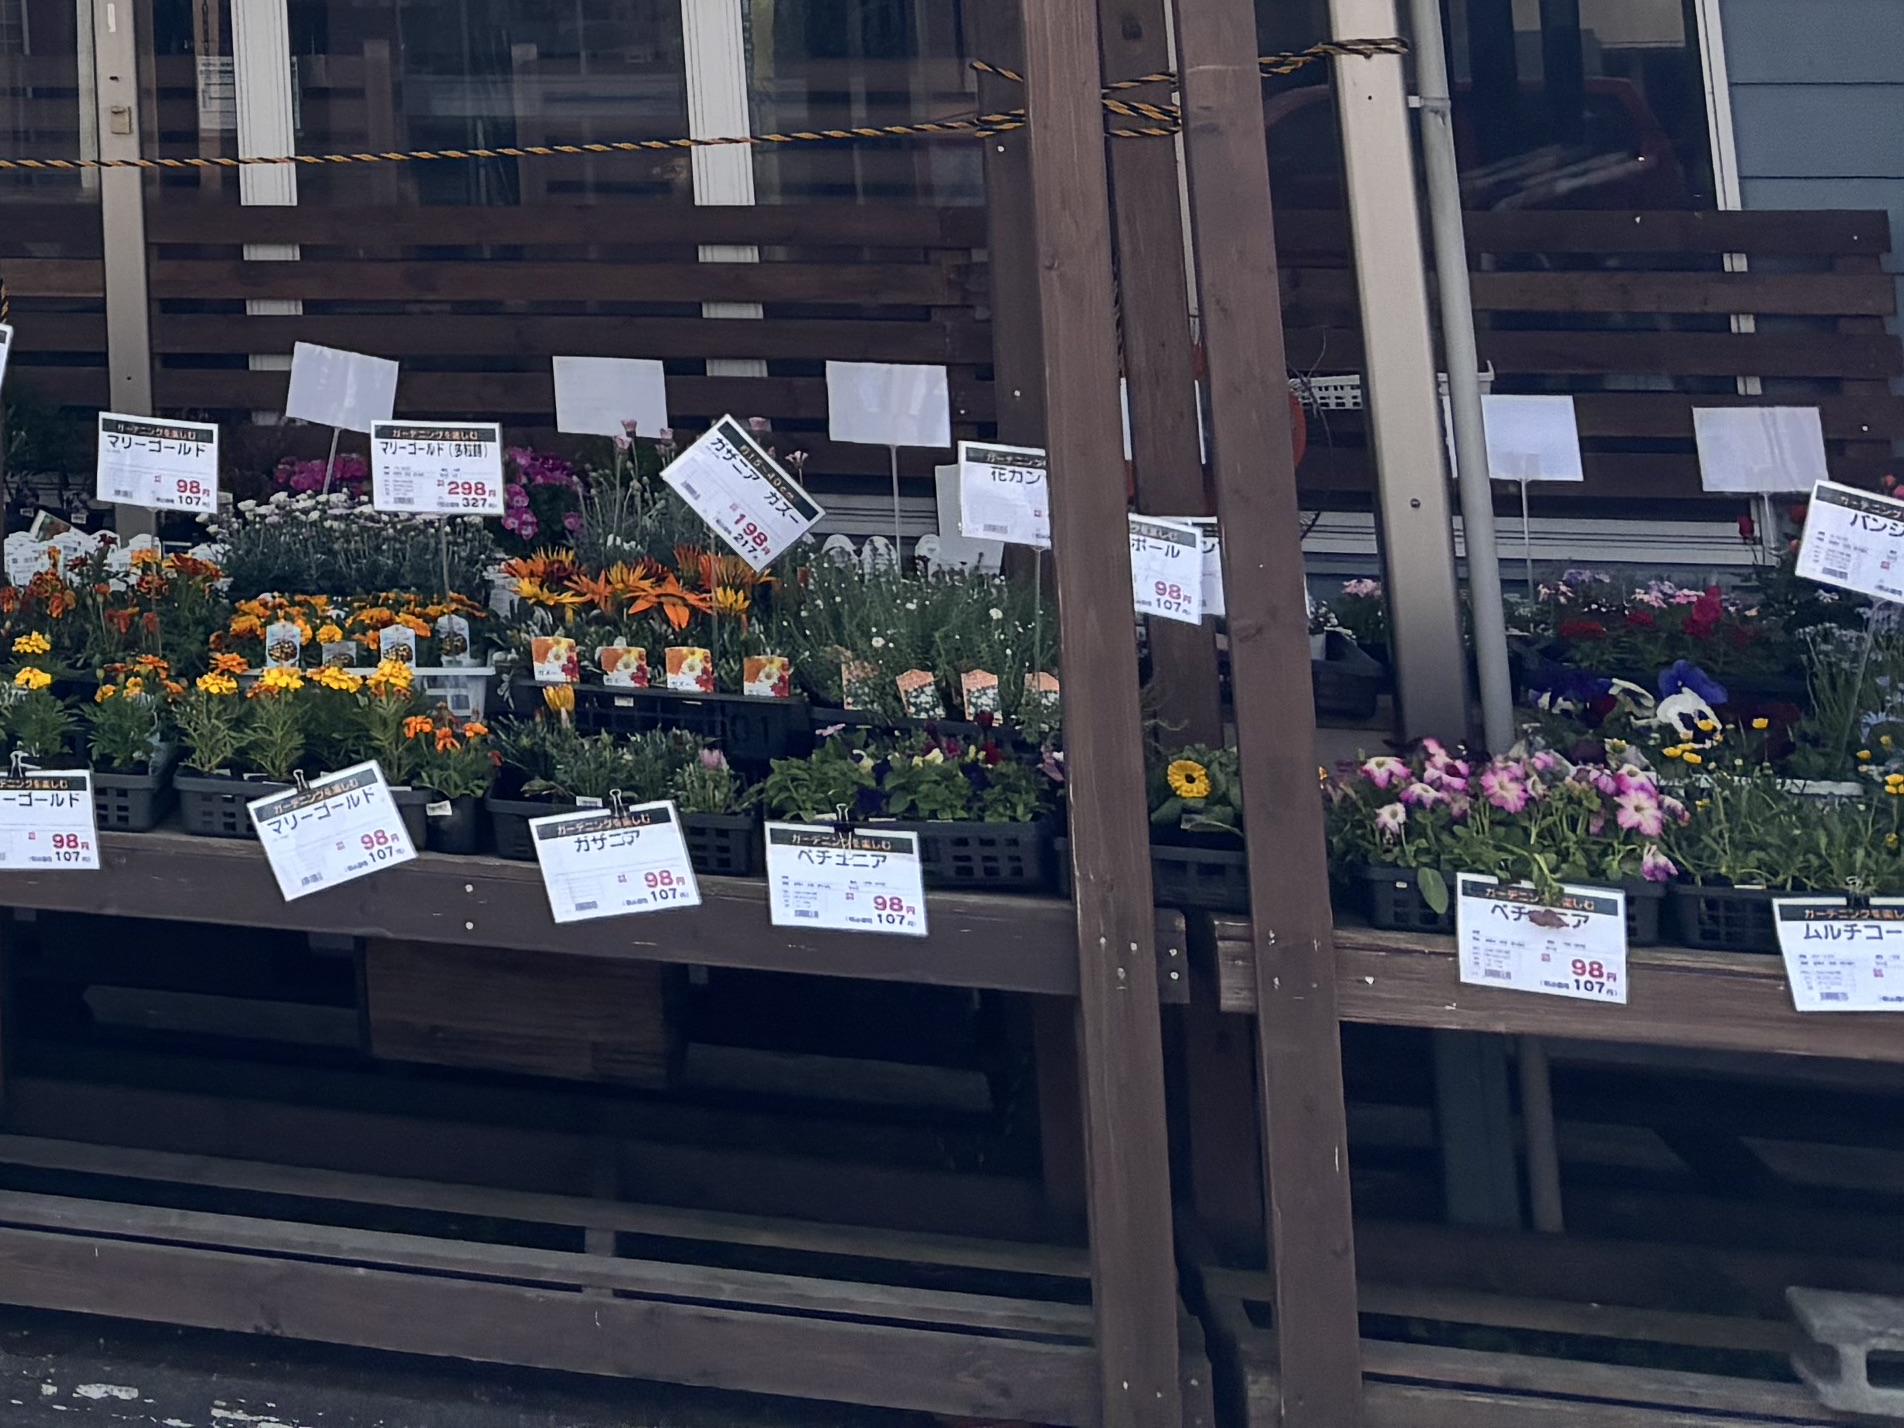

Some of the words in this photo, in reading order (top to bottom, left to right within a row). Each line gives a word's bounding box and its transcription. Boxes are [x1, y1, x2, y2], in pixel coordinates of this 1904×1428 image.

[107, 435, 206, 458] マリーゴールド
[711, 437, 760, 481] ガザニア
[267, 787, 374, 834] マリーゴールド
[574, 830, 641, 852] ガザニア
[1486, 888, 1594, 910] ガーデニン楽しむ
[1803, 923, 1903, 940] ムルチコー
